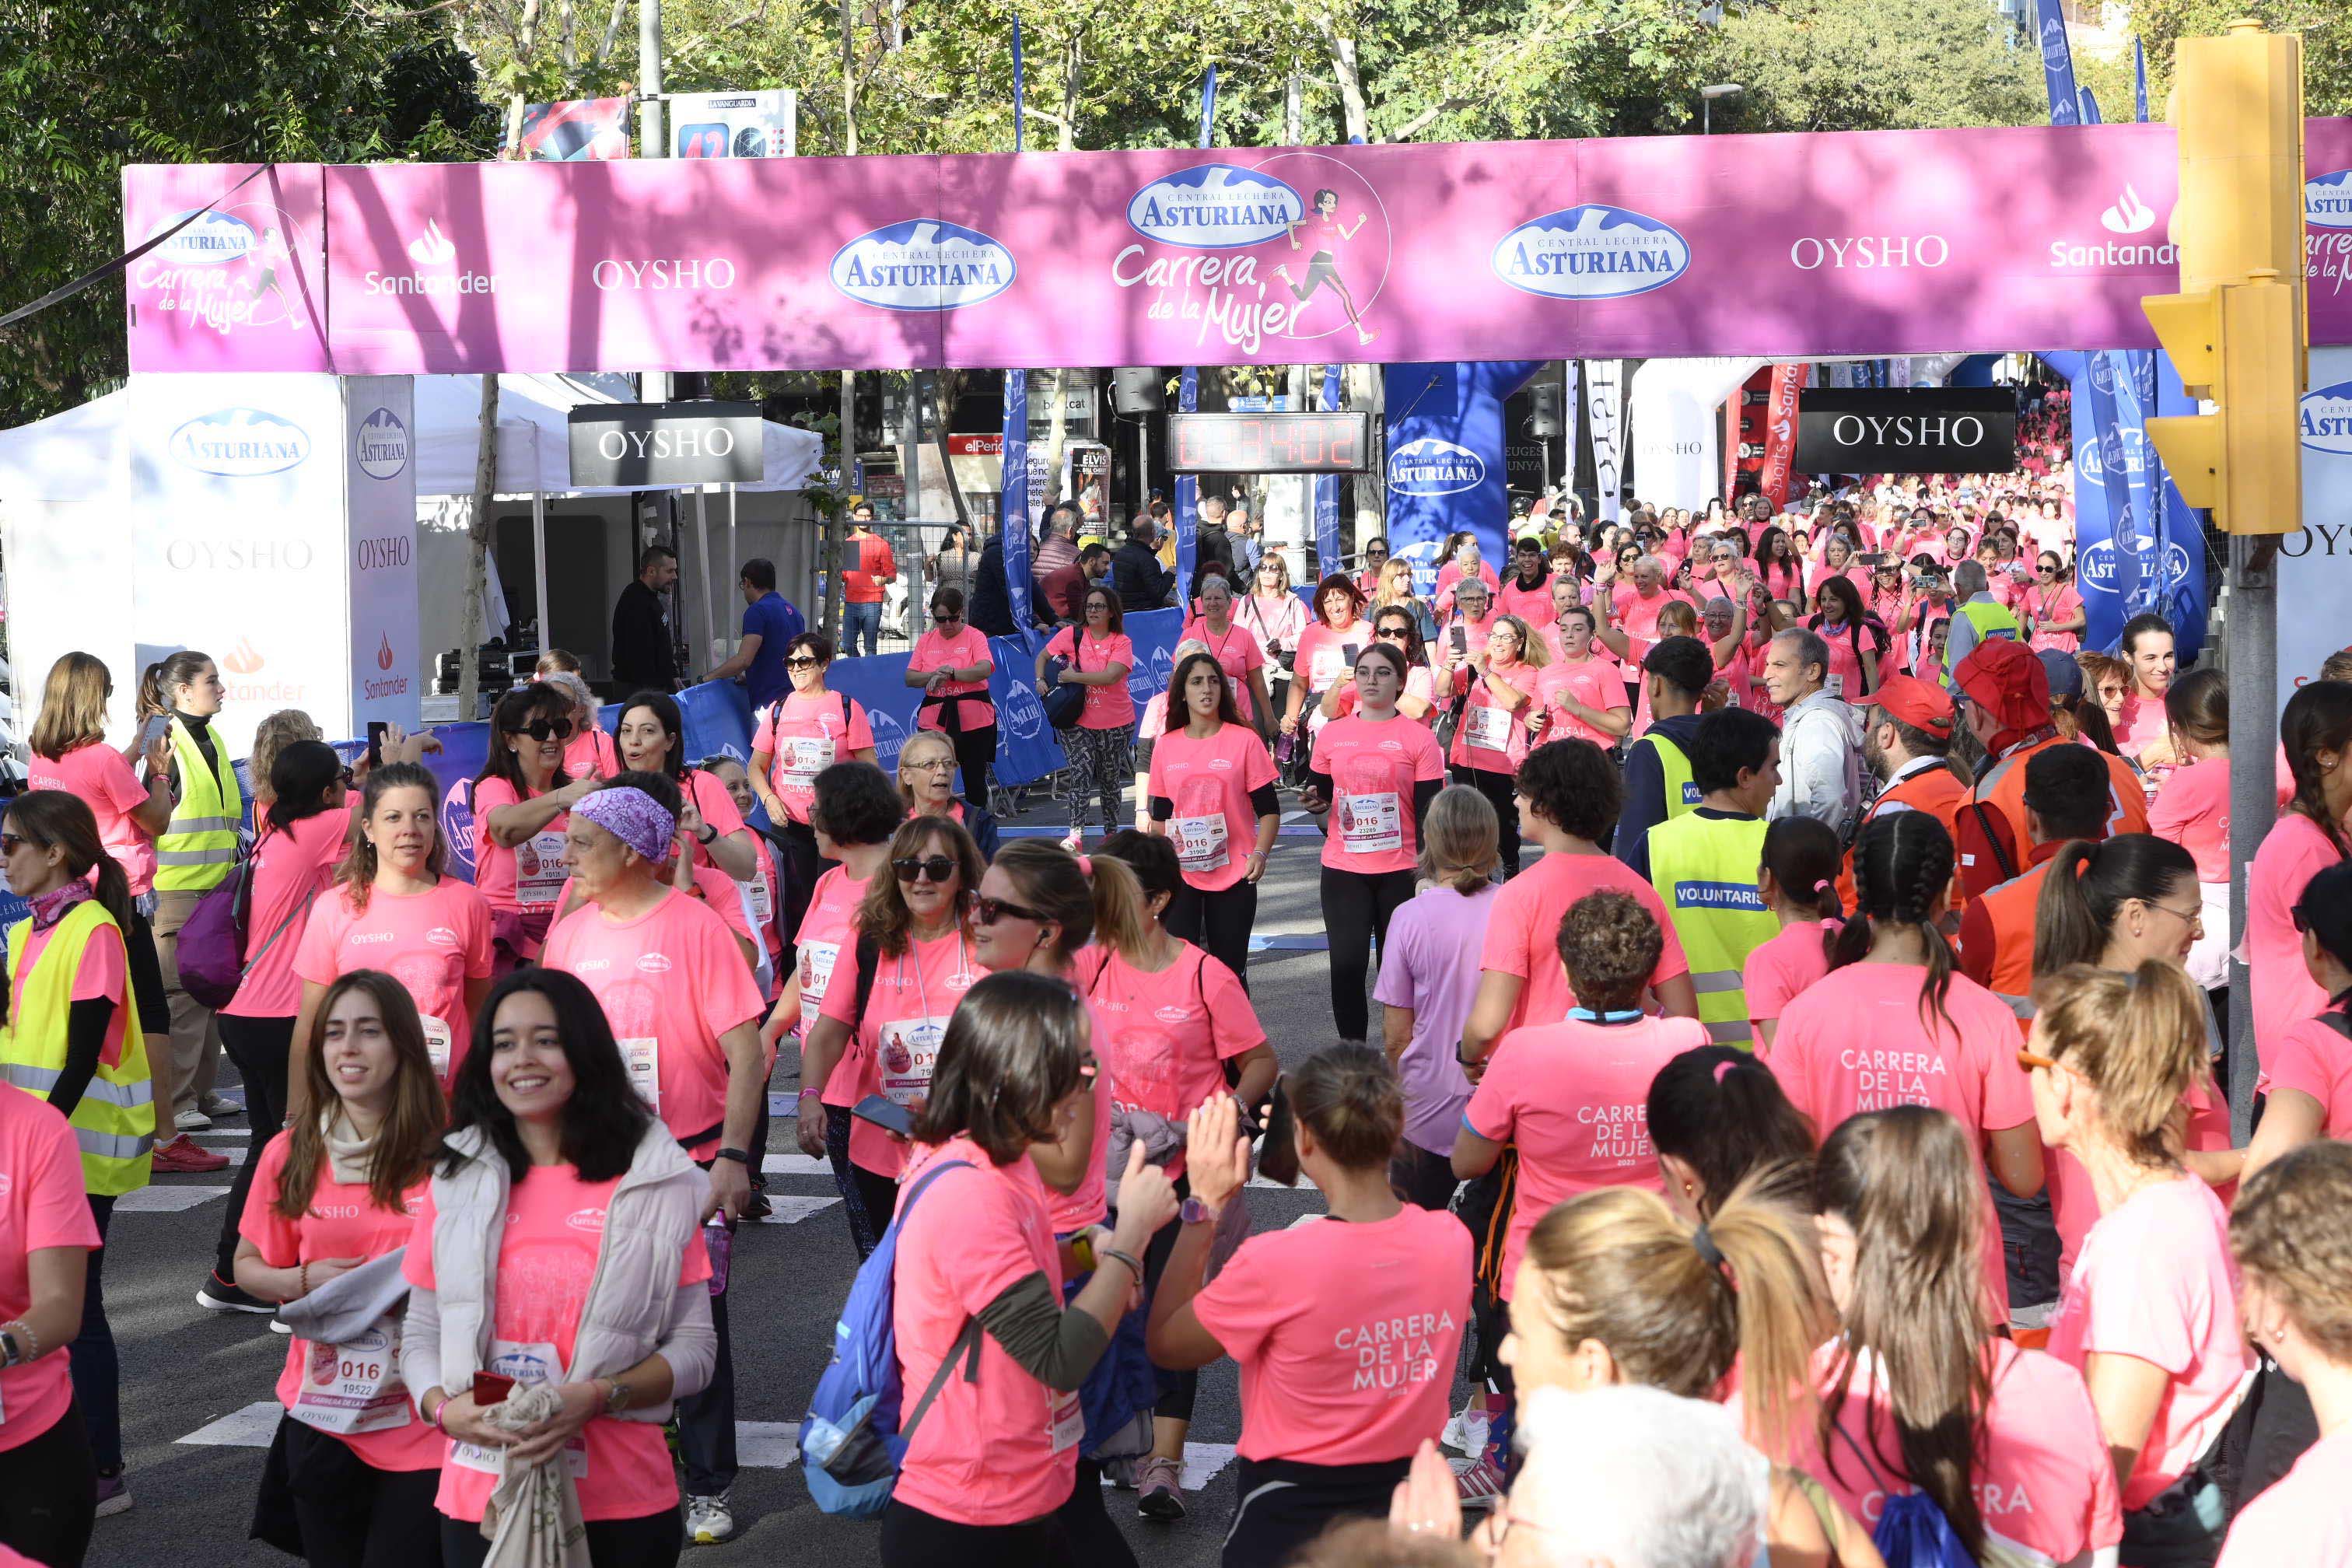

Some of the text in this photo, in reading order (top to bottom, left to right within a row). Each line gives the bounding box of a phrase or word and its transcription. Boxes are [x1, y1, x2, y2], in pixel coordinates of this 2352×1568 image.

[1168, 191, 1285, 202] CENTRAL LECHERA
[1141, 194, 1290, 229] ASTURIANA
[159, 236, 247, 250] STURIANA
[1537, 236, 1670, 247] CENTRAL LECHERA
[2305, 233, 2352, 255] arre
[873, 250, 996, 260] CENTRAL LECHERA
[1507, 240, 1675, 276] ASTURIANA
[1790, 234, 1950, 270] OYSHO
[136, 260, 232, 290] Carrera
[593, 257, 736, 291] OYSHO
[844, 254, 1003, 288] ASTURIANA
[1112, 243, 1257, 289] Carrera
[2322, 256, 2336, 277] la
[365, 268, 499, 297] Santander
[159, 287, 263, 335] de la Mujer
[1148, 282, 1312, 355] de la Mujer
[1043, 398, 1086, 411] b.cat
[1766, 362, 1799, 498] Sports Santa
[1832, 415, 1984, 447] OYSHO
[183, 433, 302, 460] ASTURIANA
[360, 435, 405, 462] ASTURIANA
[598, 427, 734, 460] OYSHO
[1505, 446, 1543, 457] EUGES
[1082, 454, 1107, 465] ELVIS
[1400, 457, 1433, 466] CENTRAL
[1507, 460, 1542, 471] UNYA
[1389, 461, 1479, 484] ASTURIANA
[2279, 523, 2352, 558] OY
[166, 537, 313, 572] OYSHO
[358, 535, 410, 570] OYSHO
[1412, 569, 1438, 584] TUR
[225, 681, 305, 702] tander
[364, 674, 408, 700] Santander
[1085, 685, 1108, 695] RSAL
[32, 775, 68, 791] CARRERA
[1684, 787, 1703, 798] VOL
[1356, 816, 1378, 826] 016
[1186, 838, 1208, 849] 016
[541, 858, 563, 870] 016
[352, 932, 394, 946] OYSHO
[814, 973, 828, 985] 01
[914, 1052, 935, 1066] 01
[1840, 1048, 1947, 1075] CARRERA
[1859, 1071, 1927, 1094] DE LA
[1577, 1104, 1647, 1124] CARRE
[1596, 1123, 1624, 1141] DE
[1590, 1139, 1654, 1158] MUJE
[1616, 1158, 1636, 1167] 2023
[1335, 1310, 1455, 1350] CARRERA
[1359, 1339, 1433, 1368] DE LA
[341, 1361, 380, 1380] 016
[495, 1363, 548, 1379] ASTURIANA
[1353, 1358, 1438, 1391] MUJER
[342, 1384, 373, 1395] 19522
[311, 1395, 341, 1406] CARRERA
[301, 1412, 338, 1423] OYSHO
